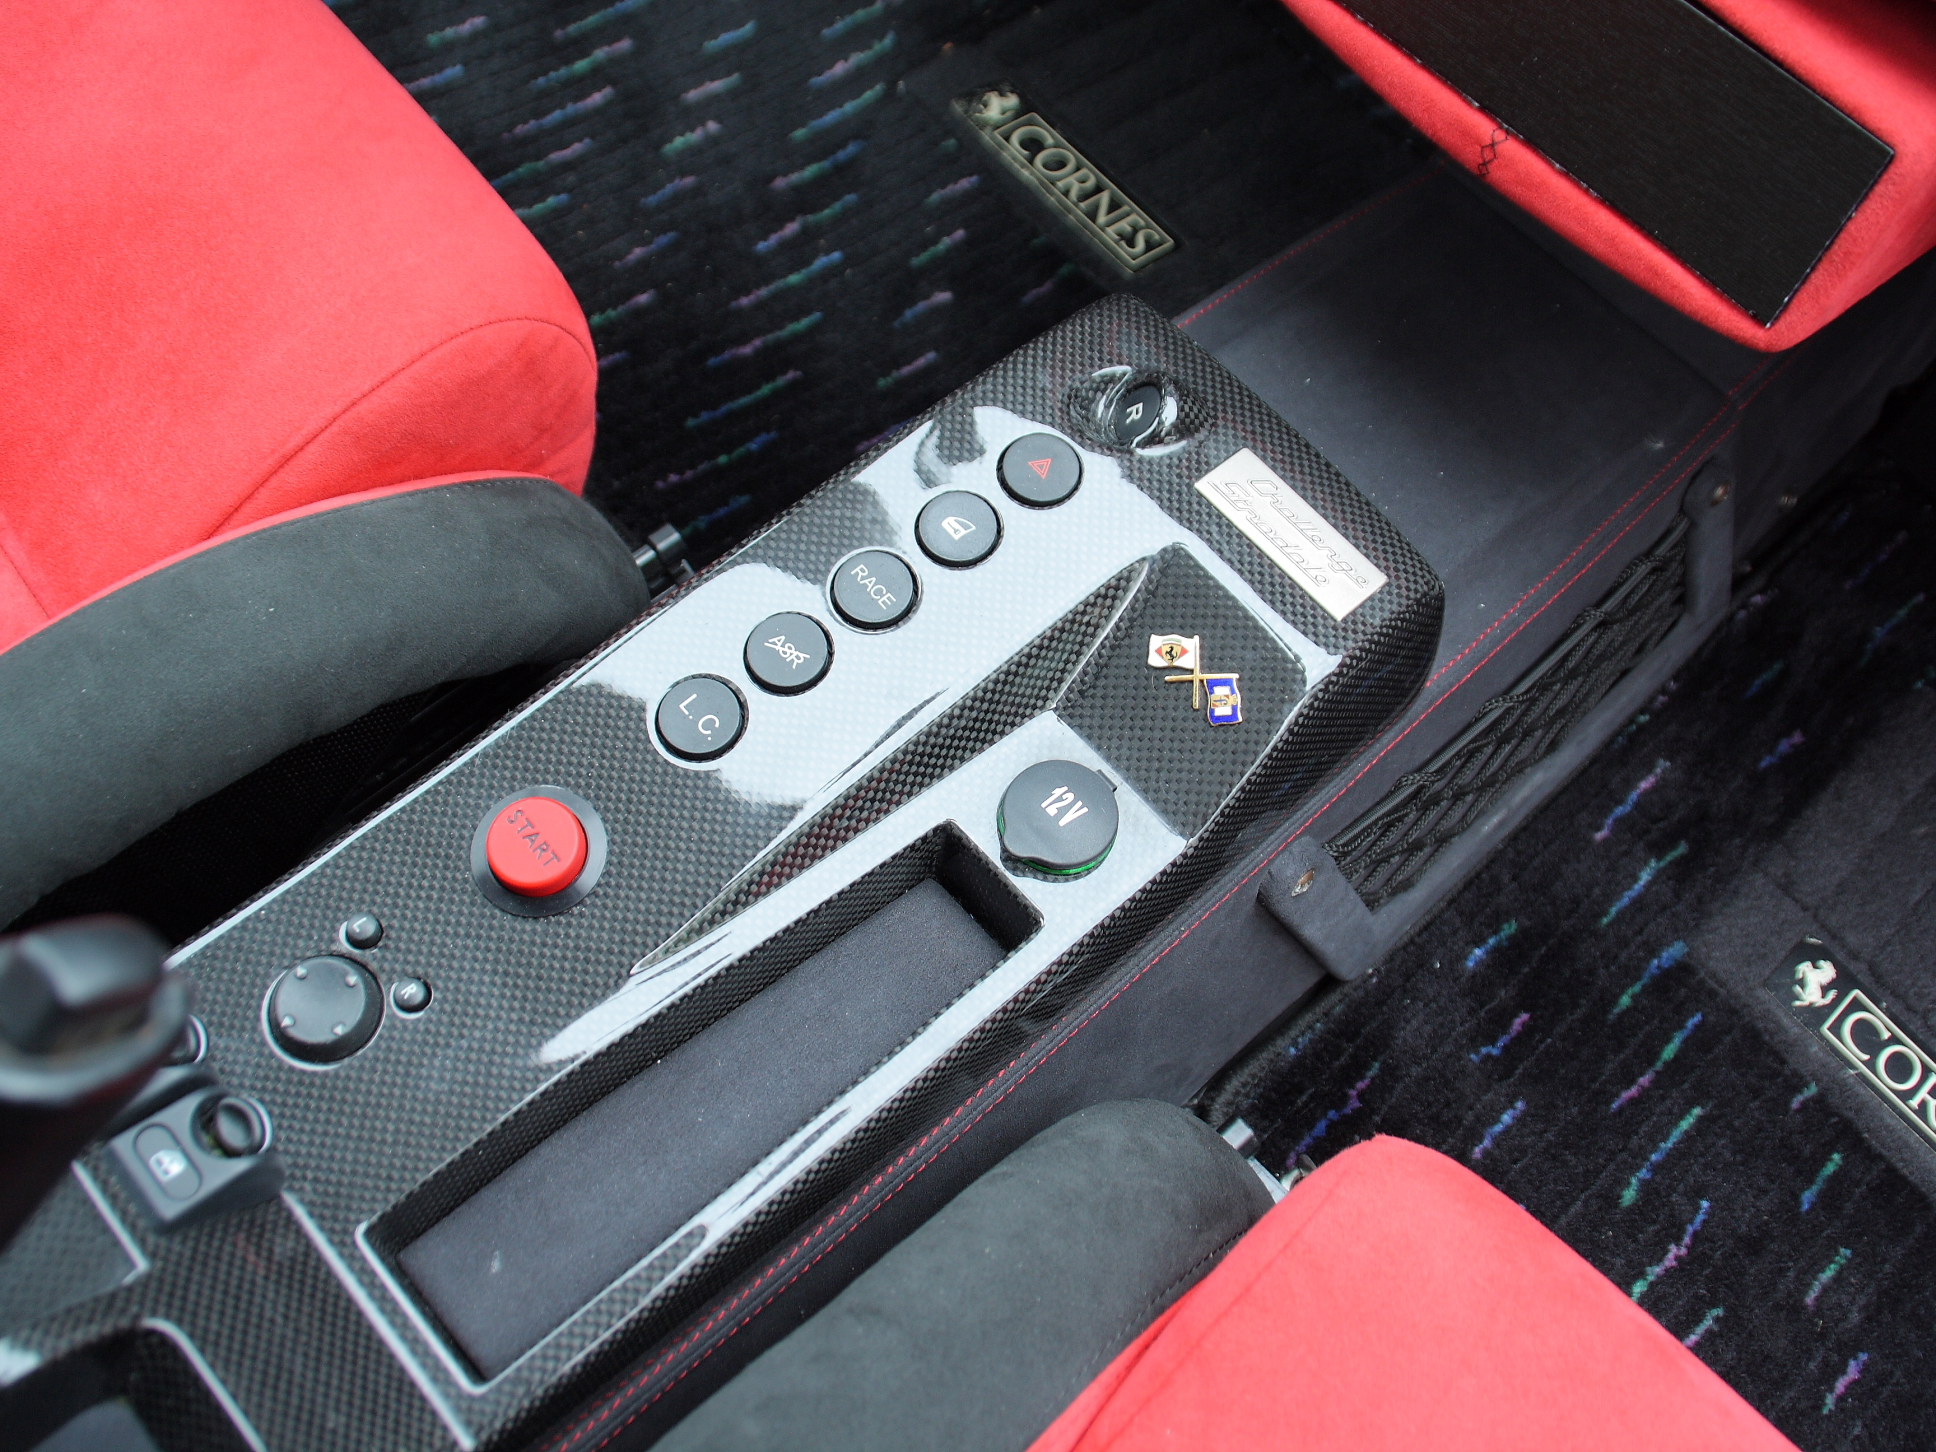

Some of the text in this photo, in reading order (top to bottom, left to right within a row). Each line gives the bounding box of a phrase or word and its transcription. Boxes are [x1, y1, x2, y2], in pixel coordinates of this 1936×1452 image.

[1009, 125, 1160, 255] CORNES
[1126, 402, 1144, 424] R
[1207, 481, 1329, 588] Stradale
[1247, 479, 1369, 589] Challenge
[850, 563, 897, 610] RACE
[764, 635, 811, 669] ASR
[1040, 785, 1089, 827] 12V
[506, 809, 561, 867] START
[352, 916, 367, 933] L
[400, 982, 417, 999] R
